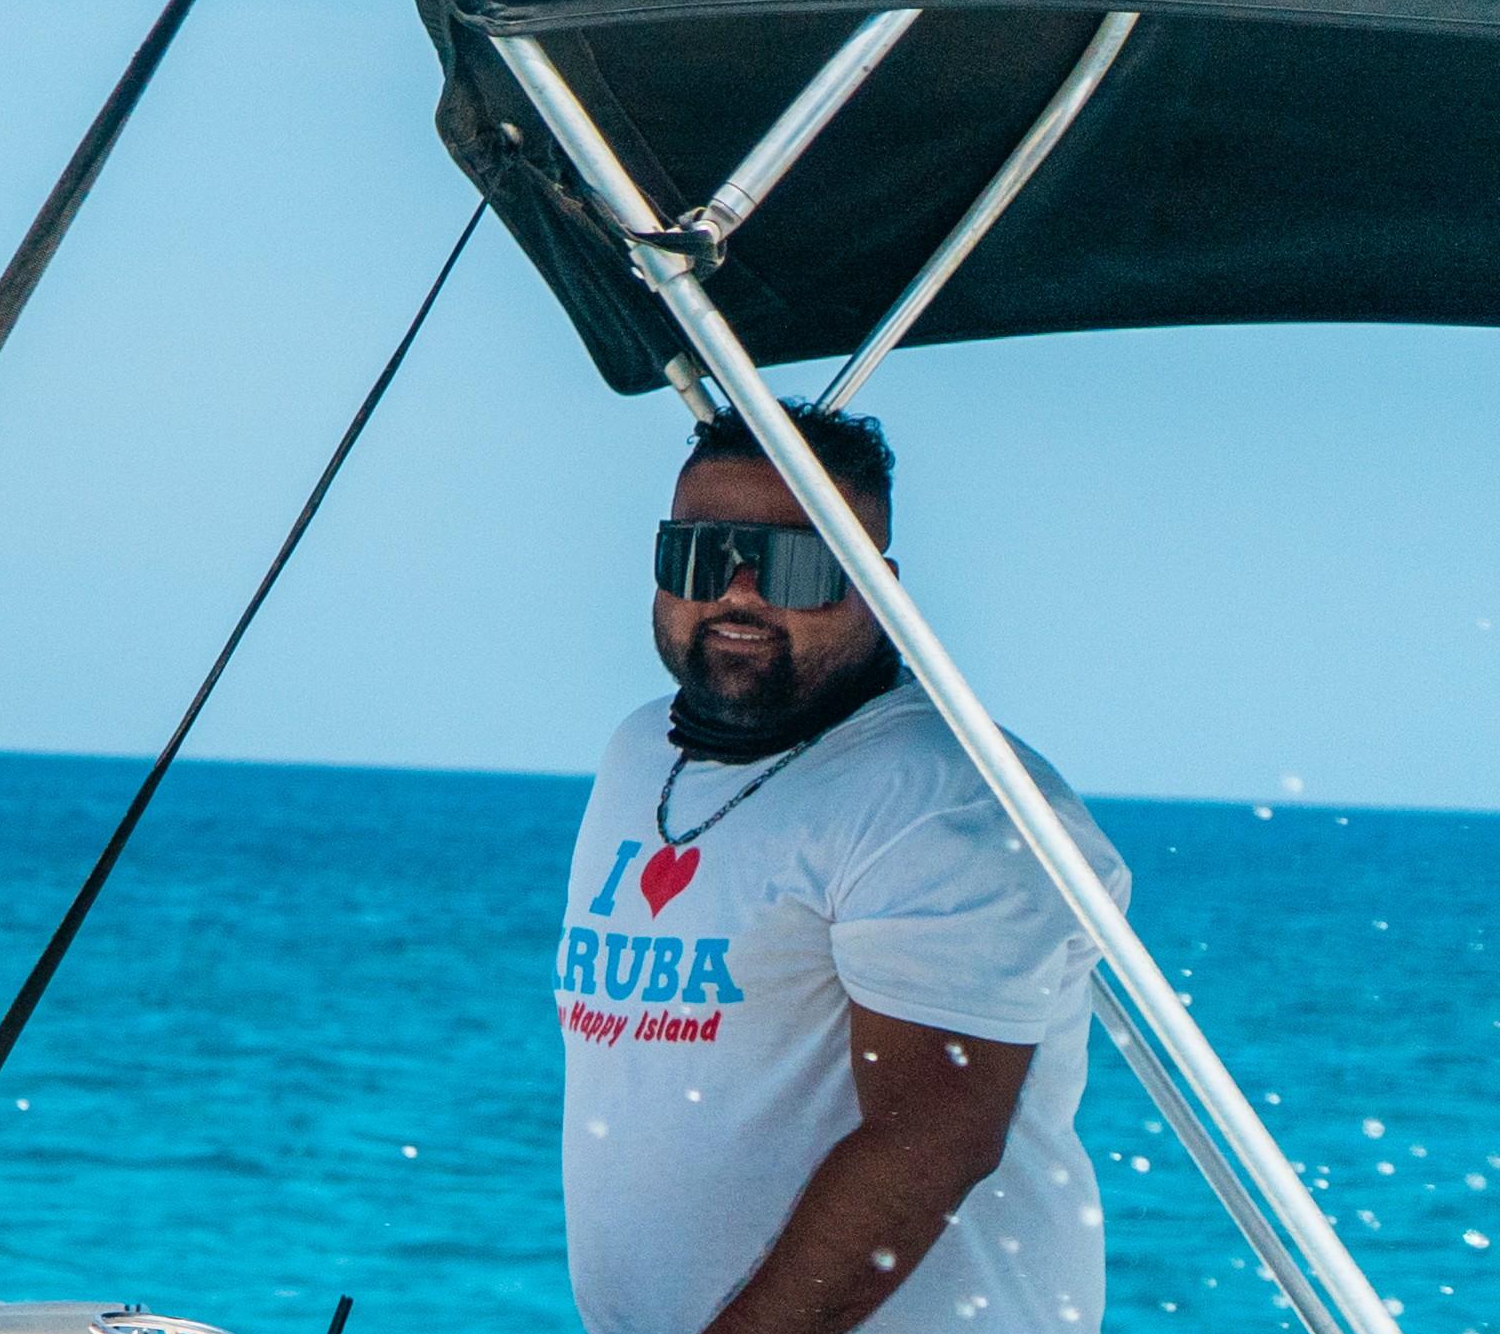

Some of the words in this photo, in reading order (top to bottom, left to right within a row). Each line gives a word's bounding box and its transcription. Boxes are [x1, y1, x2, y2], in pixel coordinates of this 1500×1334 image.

[589, 839, 642, 917] I
[553, 926, 745, 1004] RUBA
[569, 1000, 628, 1048] Happy
[634, 1009, 722, 1042] Island
